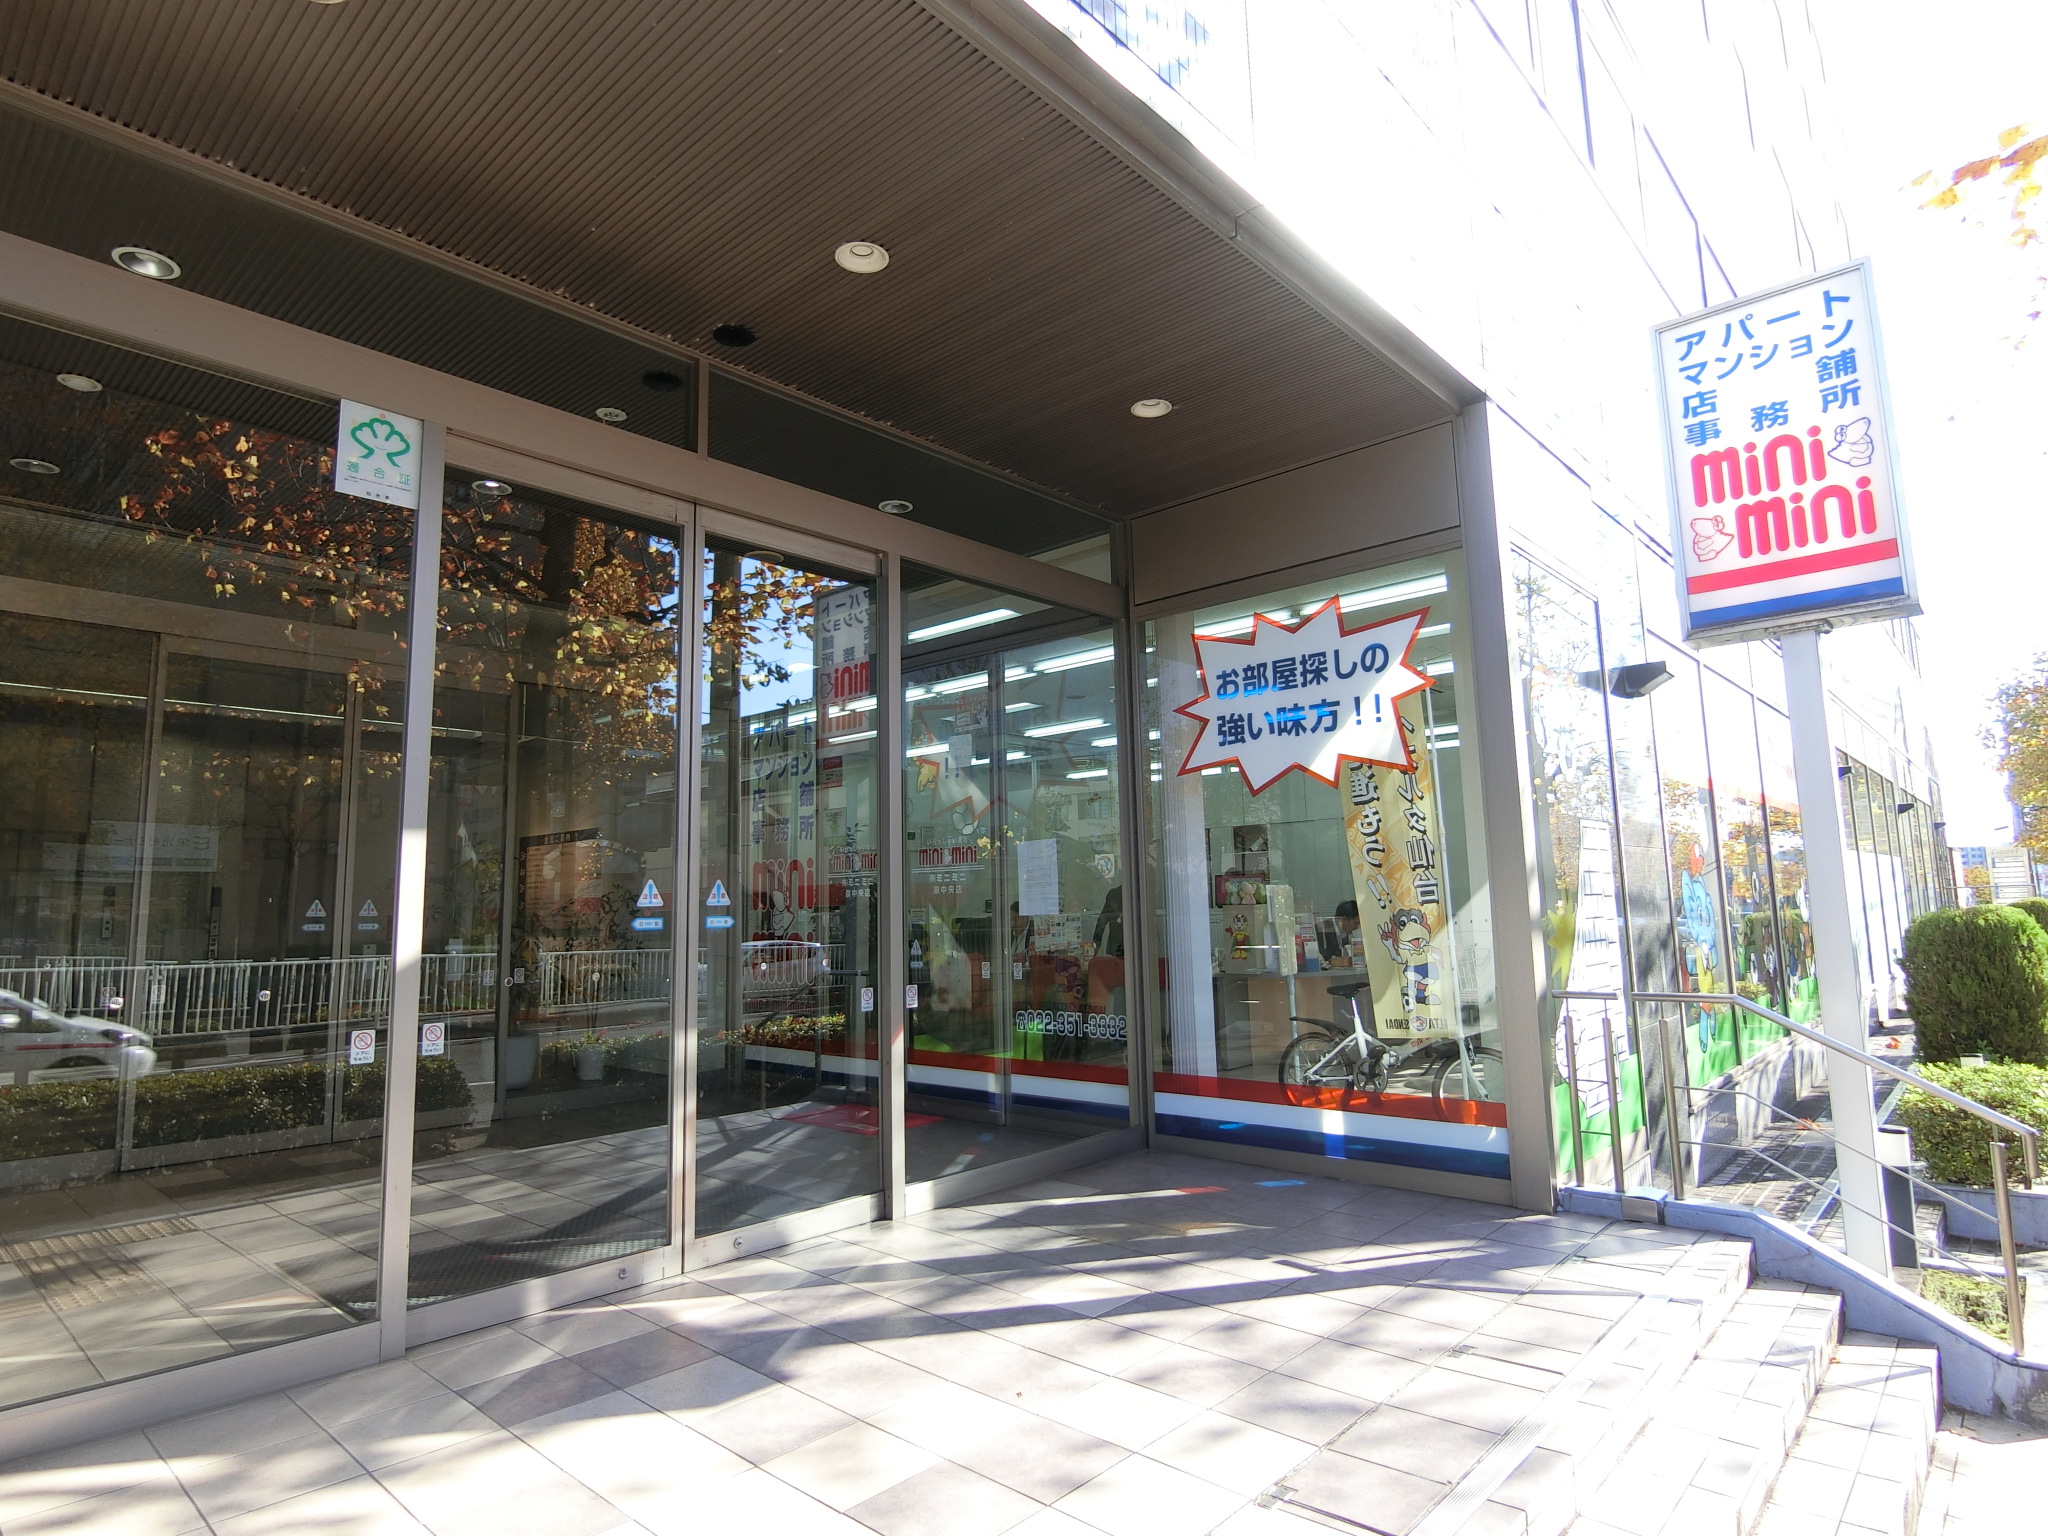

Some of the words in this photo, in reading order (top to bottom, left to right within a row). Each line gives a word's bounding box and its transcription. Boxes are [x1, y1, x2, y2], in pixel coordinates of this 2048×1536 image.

[1675, 290, 1850, 361] アパート
[1679, 320, 1853, 386] マンション
[1684, 379, 1862, 447] 事務所
[1690, 425, 1827, 508] mini
[1734, 476, 1878, 559] mini
[1215, 642, 1390, 701] お部屋探しの
[753, 751, 814, 780] マンション
[752, 813, 815, 844] 事務所
[918, 847, 944, 867] mini
[951, 845, 978, 865] mini
[752, 857, 816, 912] mini
